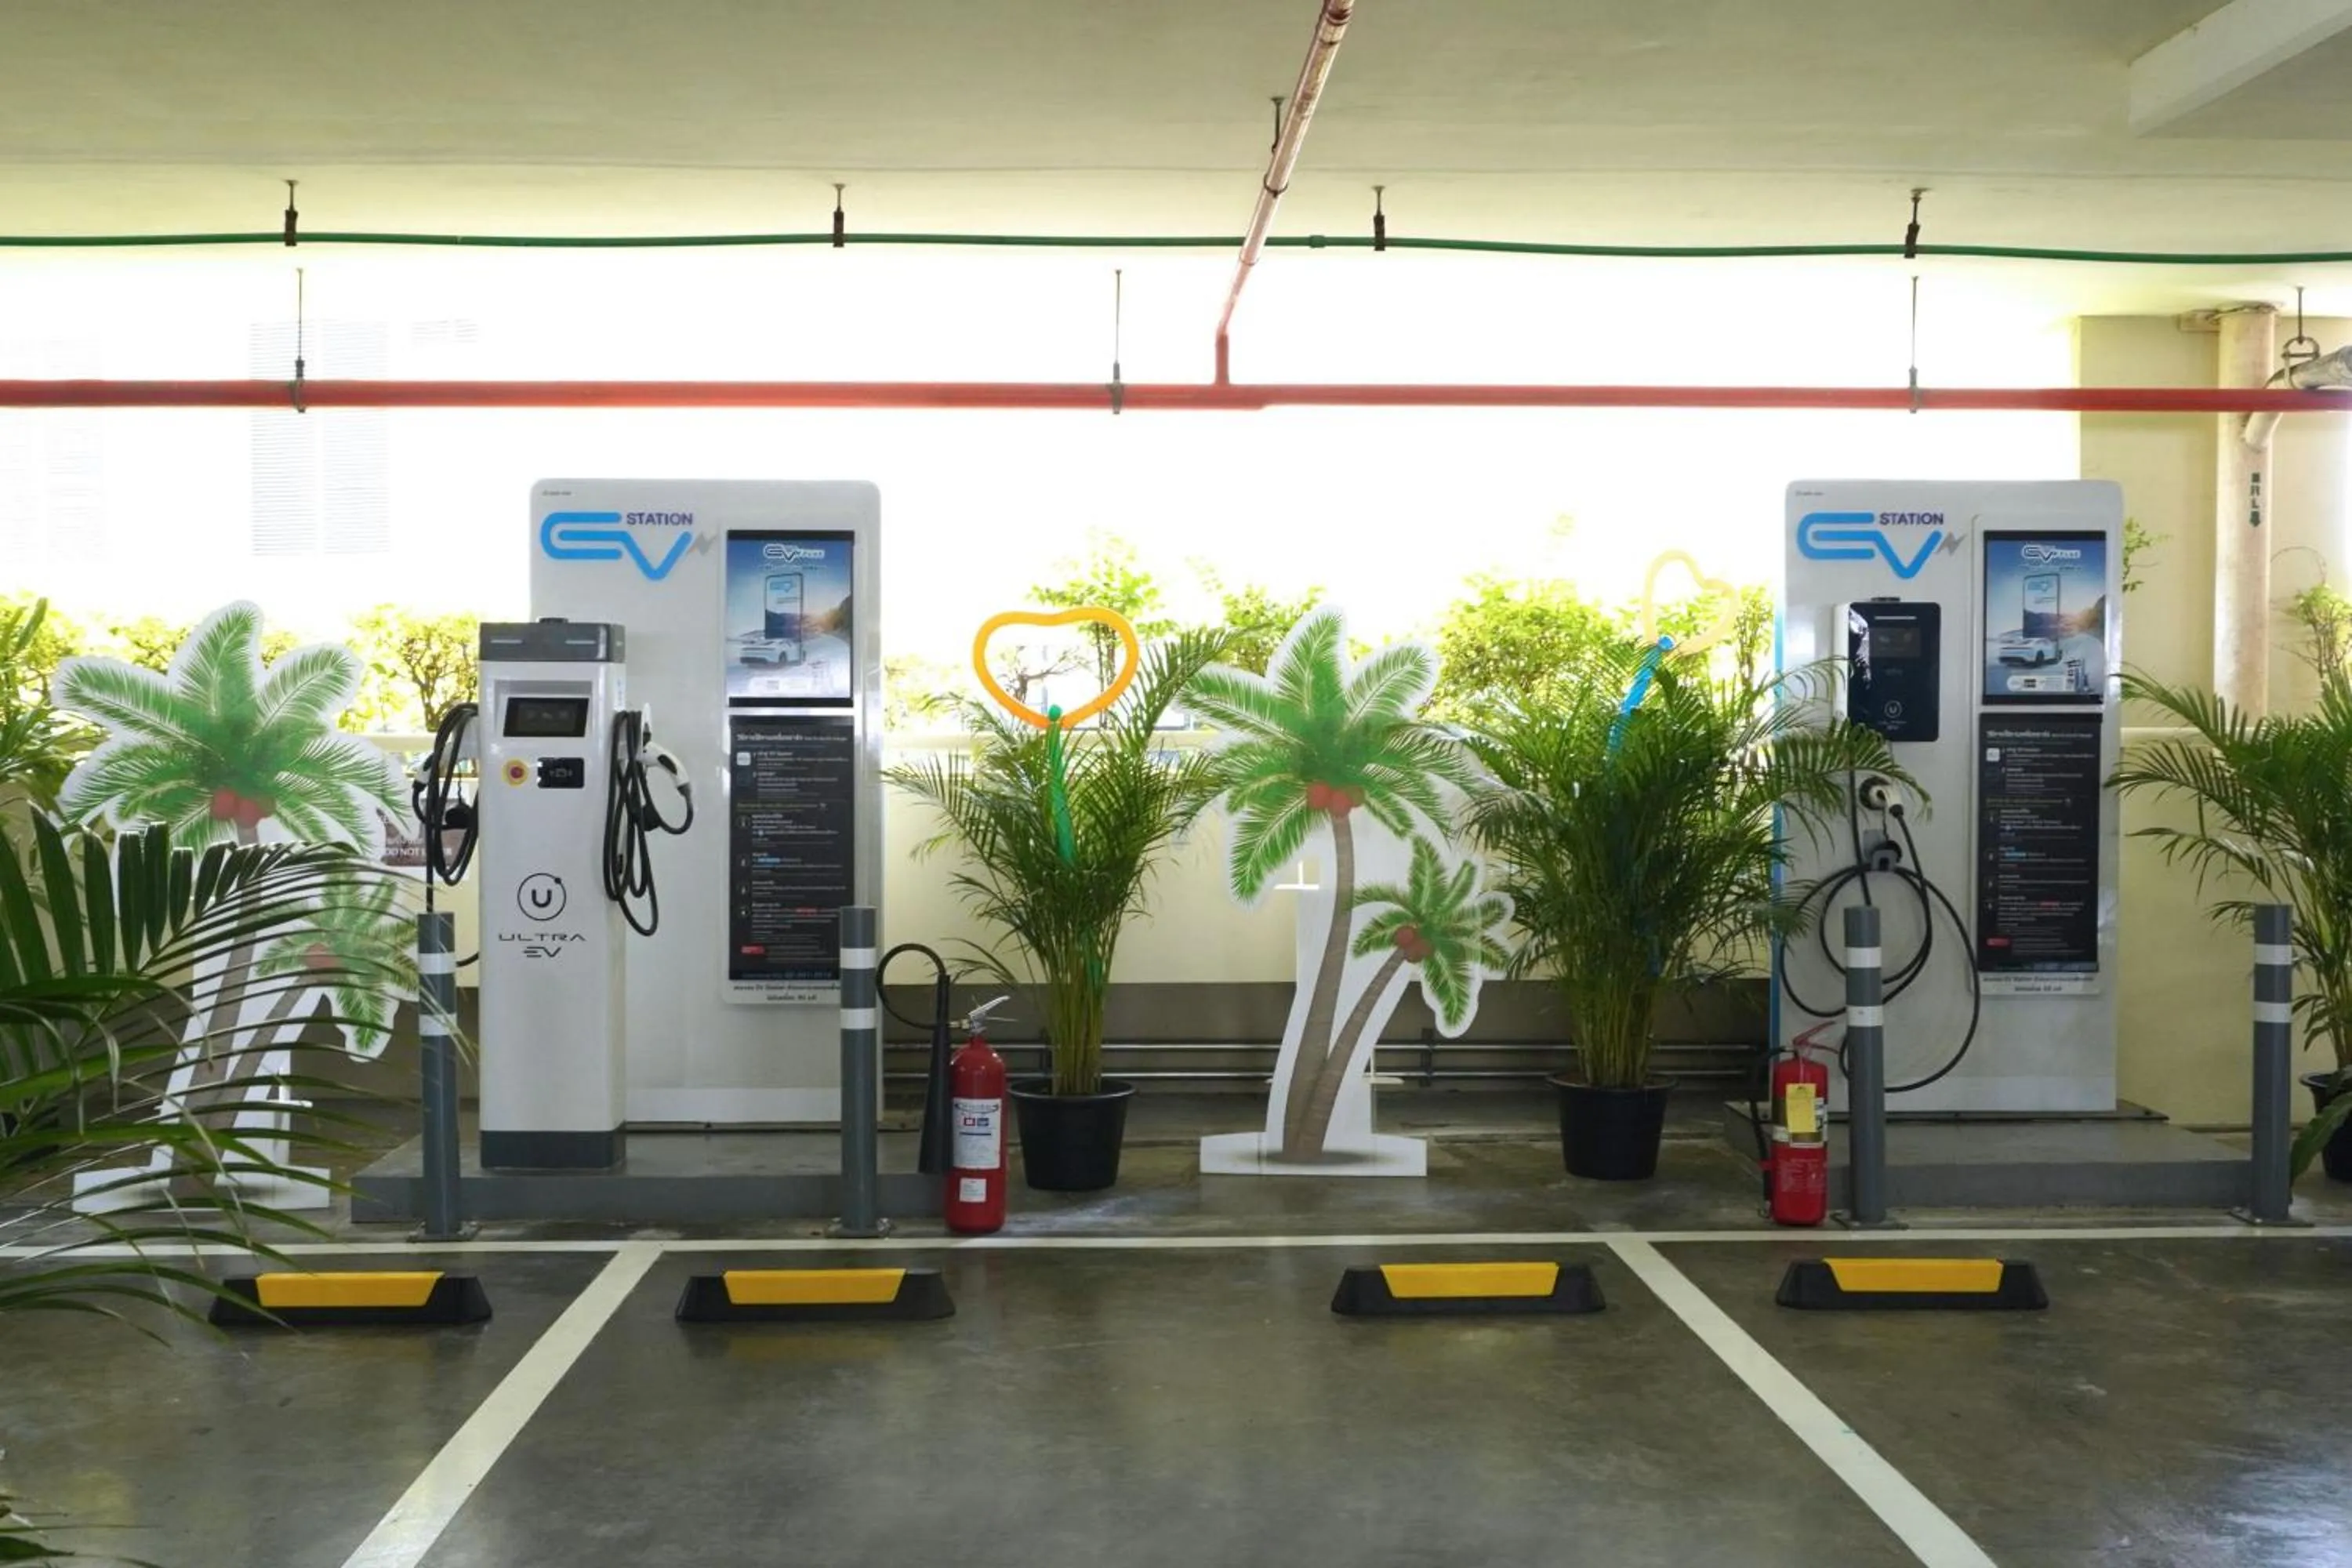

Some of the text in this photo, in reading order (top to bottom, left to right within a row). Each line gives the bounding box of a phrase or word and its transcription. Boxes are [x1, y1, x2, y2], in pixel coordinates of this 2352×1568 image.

[626, 513, 693, 526] STATION
[1879, 513, 1944, 525] STATION
[540, 511, 692, 581] EV
[1797, 511, 1942, 579] EV
[531, 888, 552, 908] U
[498, 932, 586, 942] ULTRA
[523, 946, 562, 958] EV
